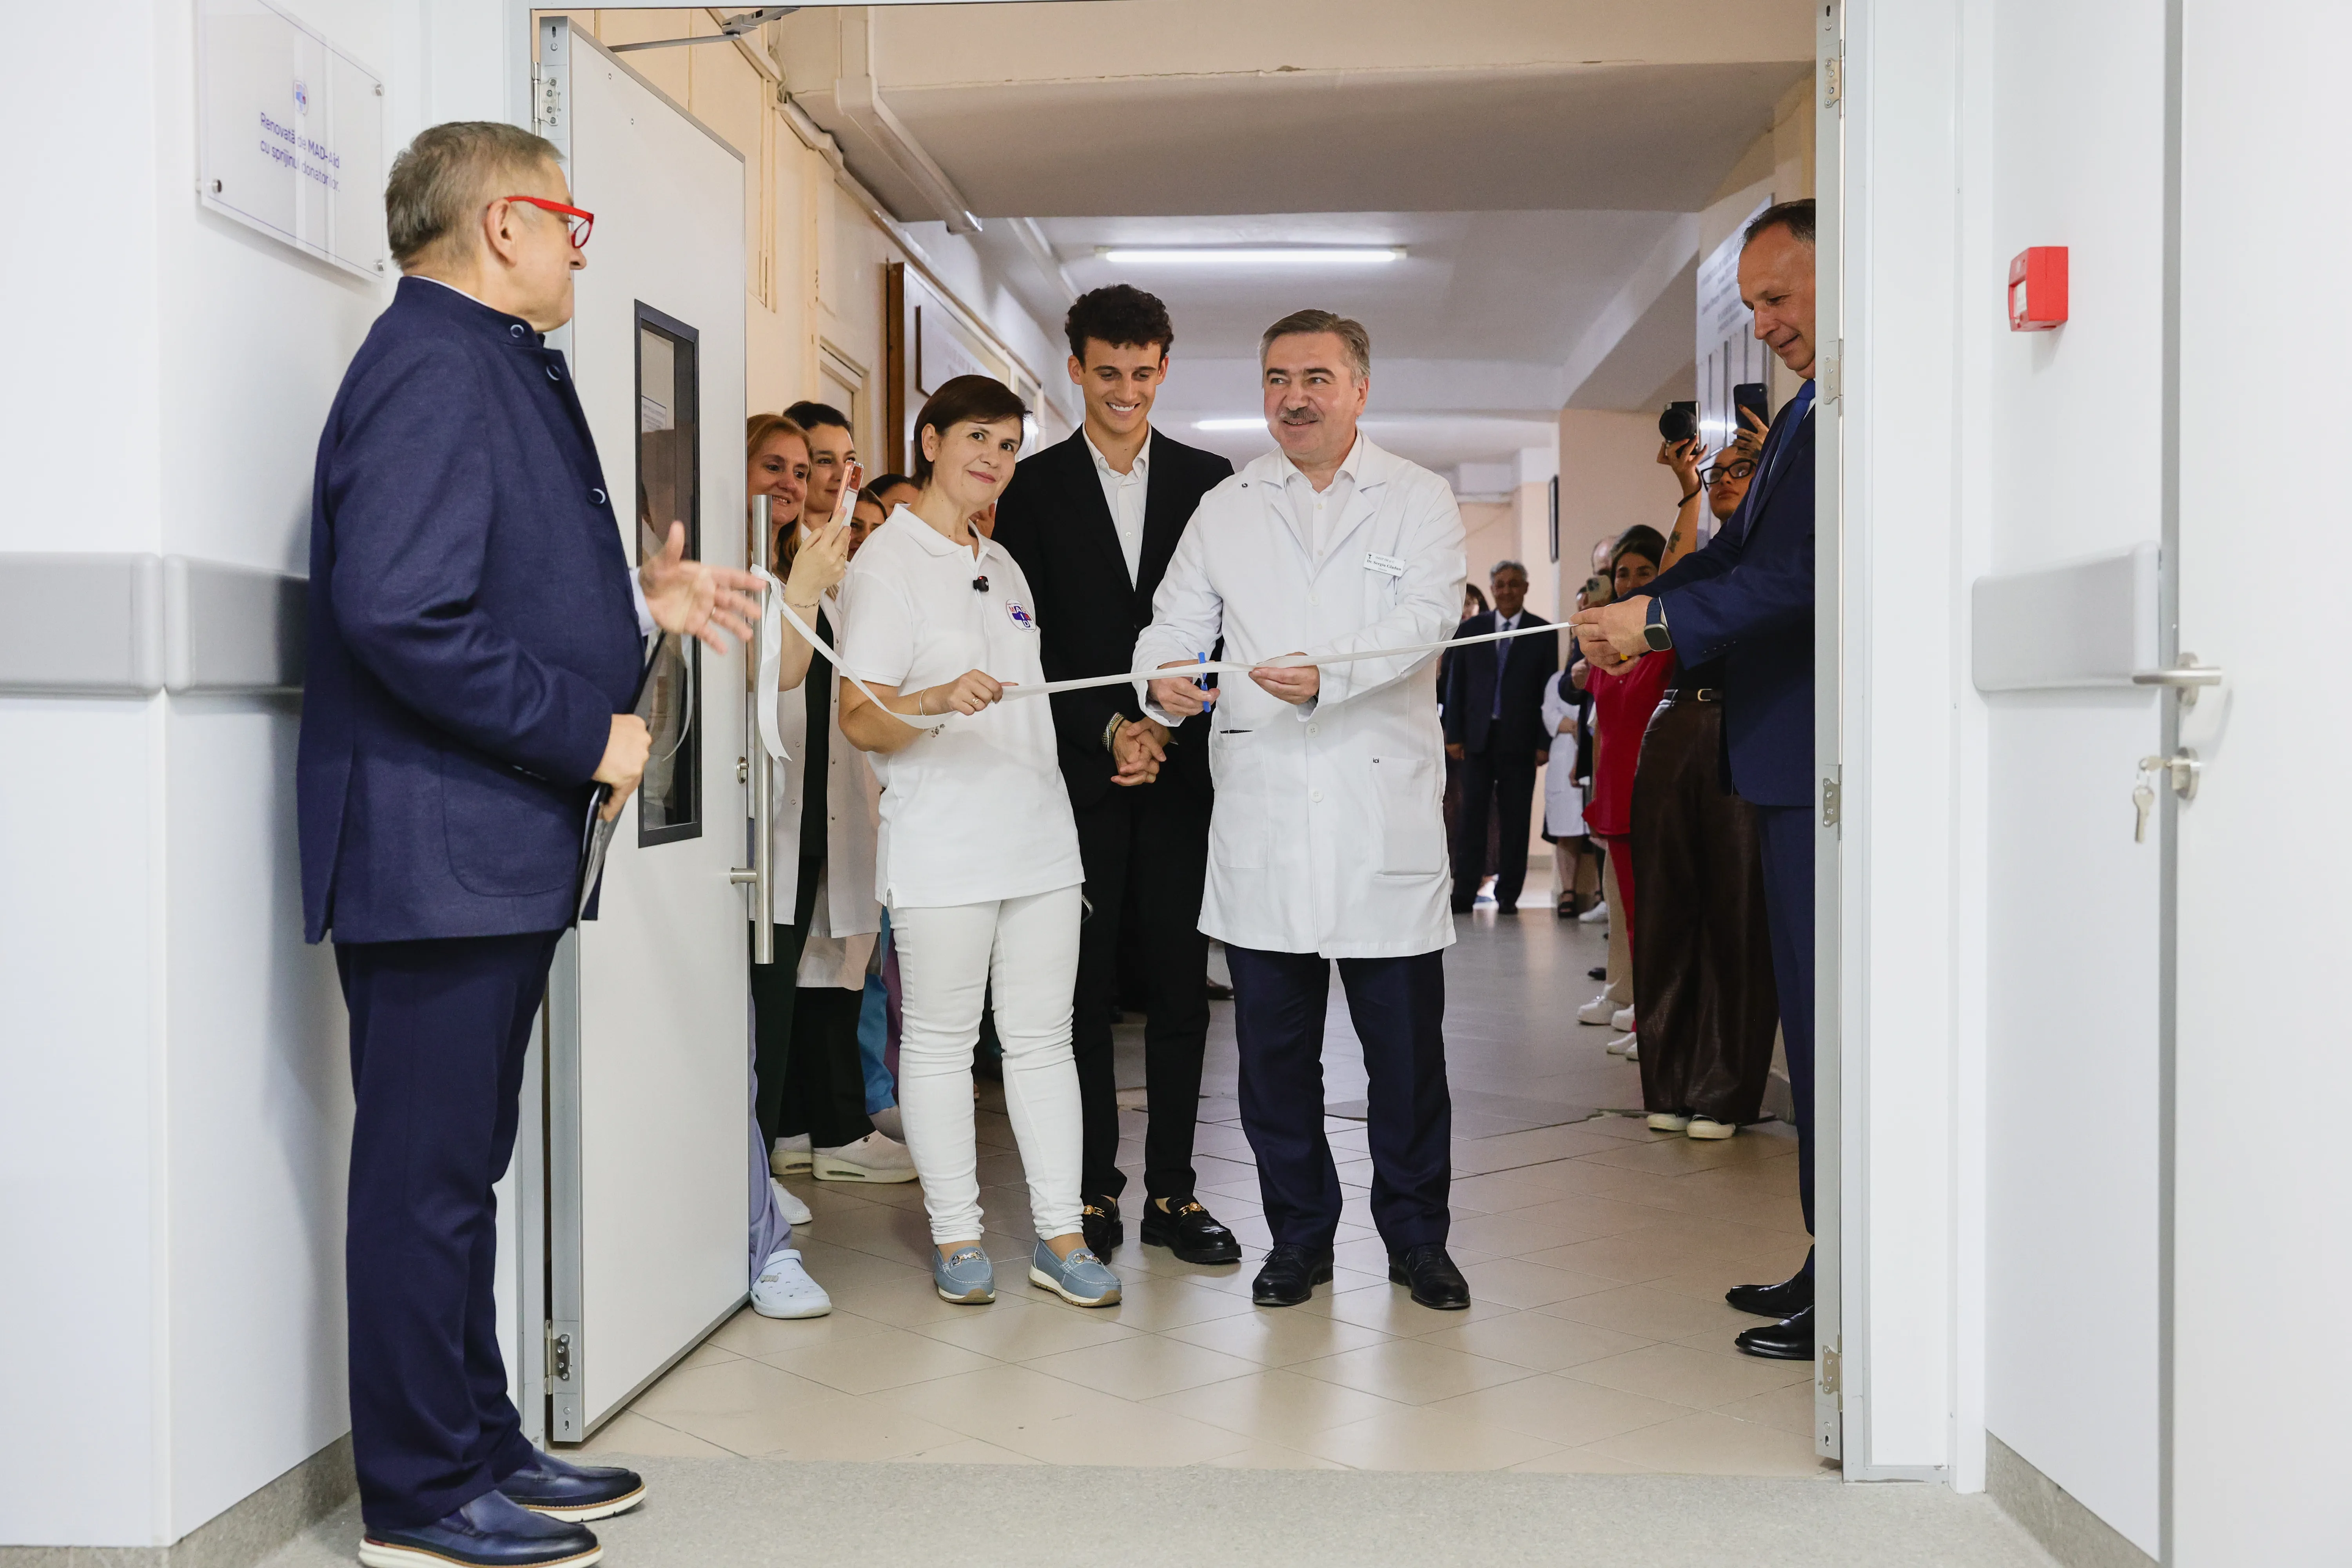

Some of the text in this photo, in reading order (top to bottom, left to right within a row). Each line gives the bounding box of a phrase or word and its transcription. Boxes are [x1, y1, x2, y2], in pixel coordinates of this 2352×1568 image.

[260, 111, 340, 169] Renovată de MAD-Aid
[260, 140, 270, 154] cu
